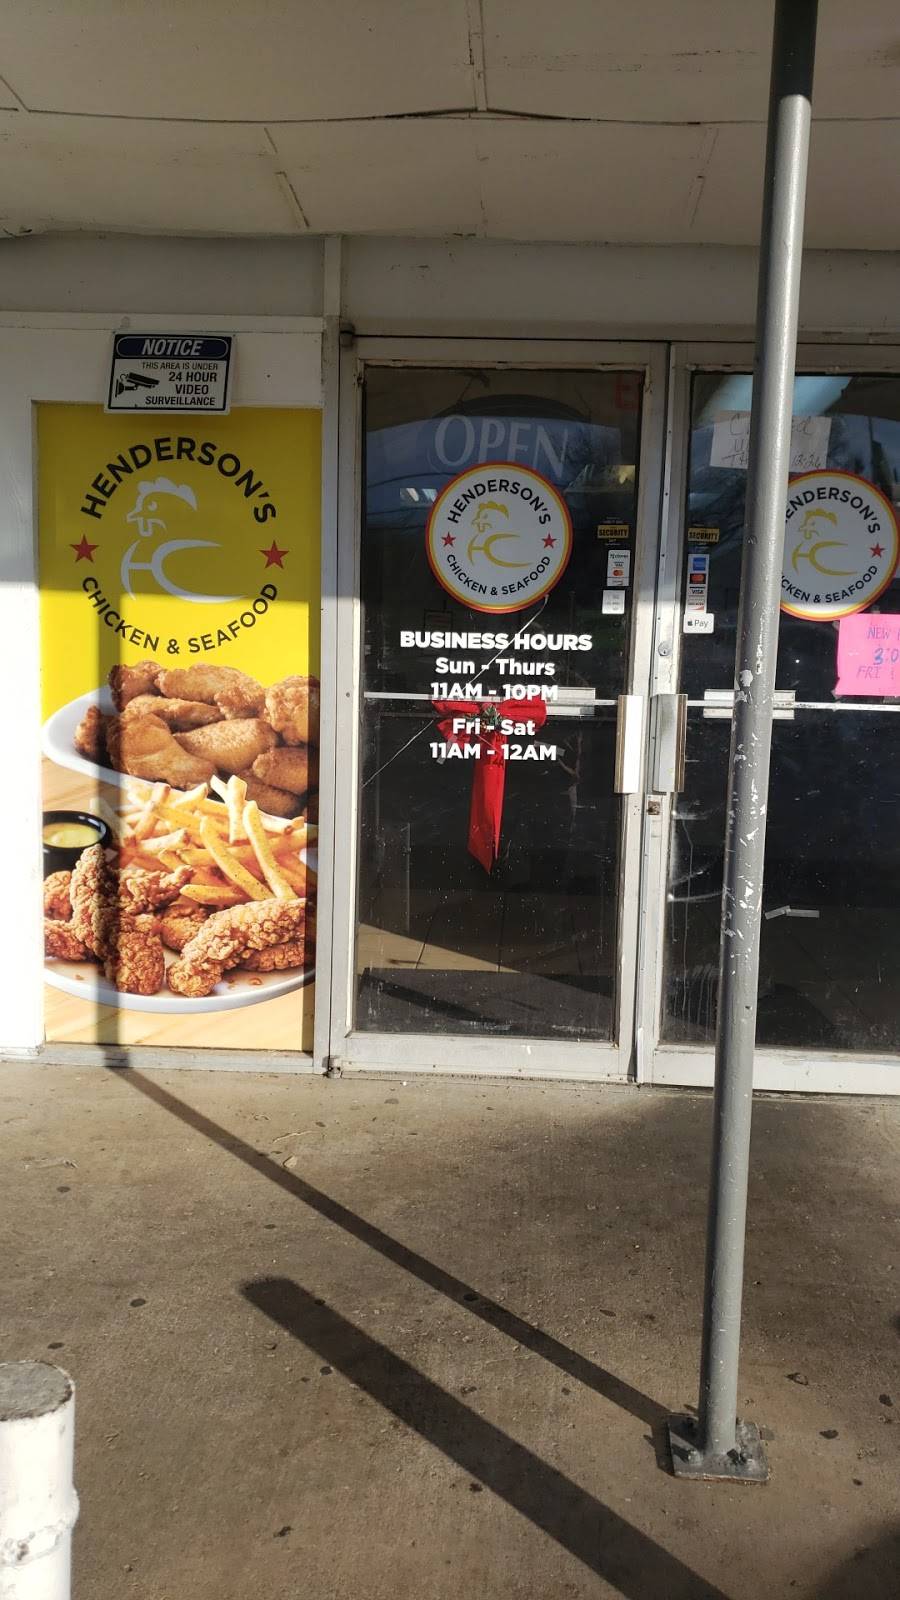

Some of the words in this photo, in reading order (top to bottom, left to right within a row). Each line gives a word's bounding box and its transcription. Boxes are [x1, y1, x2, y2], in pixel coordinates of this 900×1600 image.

[141, 338, 203, 356] NOTICE
[142, 361, 159, 370] THIS
[160, 362, 180, 370] AREA
[182, 362, 190, 370] IS
[192, 362, 218, 370] UNDER
[168, 371, 183, 382] 24
[186, 372, 217, 382] HOUR
[175, 384, 209, 395] VIDEO
[145, 395, 216, 406] SURVEILLANCE
[434, 414, 569, 480] OPEN
[80, 436, 277, 523] HENDERSON'S
[447, 479, 551, 525] HENDERSON'S
[785, 487, 881, 534] ENDERSON'S
[598, 528, 628, 537] SECURITY
[688, 531, 719, 540] SECURITY
[446, 554, 487, 595] CHICKEN
[490, 587, 498, 596] &
[501, 556, 551, 595] SEAFOOD
[813, 594, 822, 603] &
[825, 565, 878, 603] SEAFOOD
[82, 577, 160, 651] CHICKEN
[166, 638, 180, 655] &
[188, 583, 278, 653] SEAFOOD
[694, 619, 709, 628] Pay
[400, 630, 509, 649] BUSINESS
[514, 634, 593, 651] HOURS
[435, 657, 475, 674] Sun
[495, 658, 555, 676] Thurs
[430, 682, 483, 699] 11AM
[502, 684, 559, 701] 10PM
[452, 718, 481, 735] Fri
[500, 719, 536, 736] Sat
[429, 742, 481, 759] 11AM
[501, 744, 557, 761] 12AM
